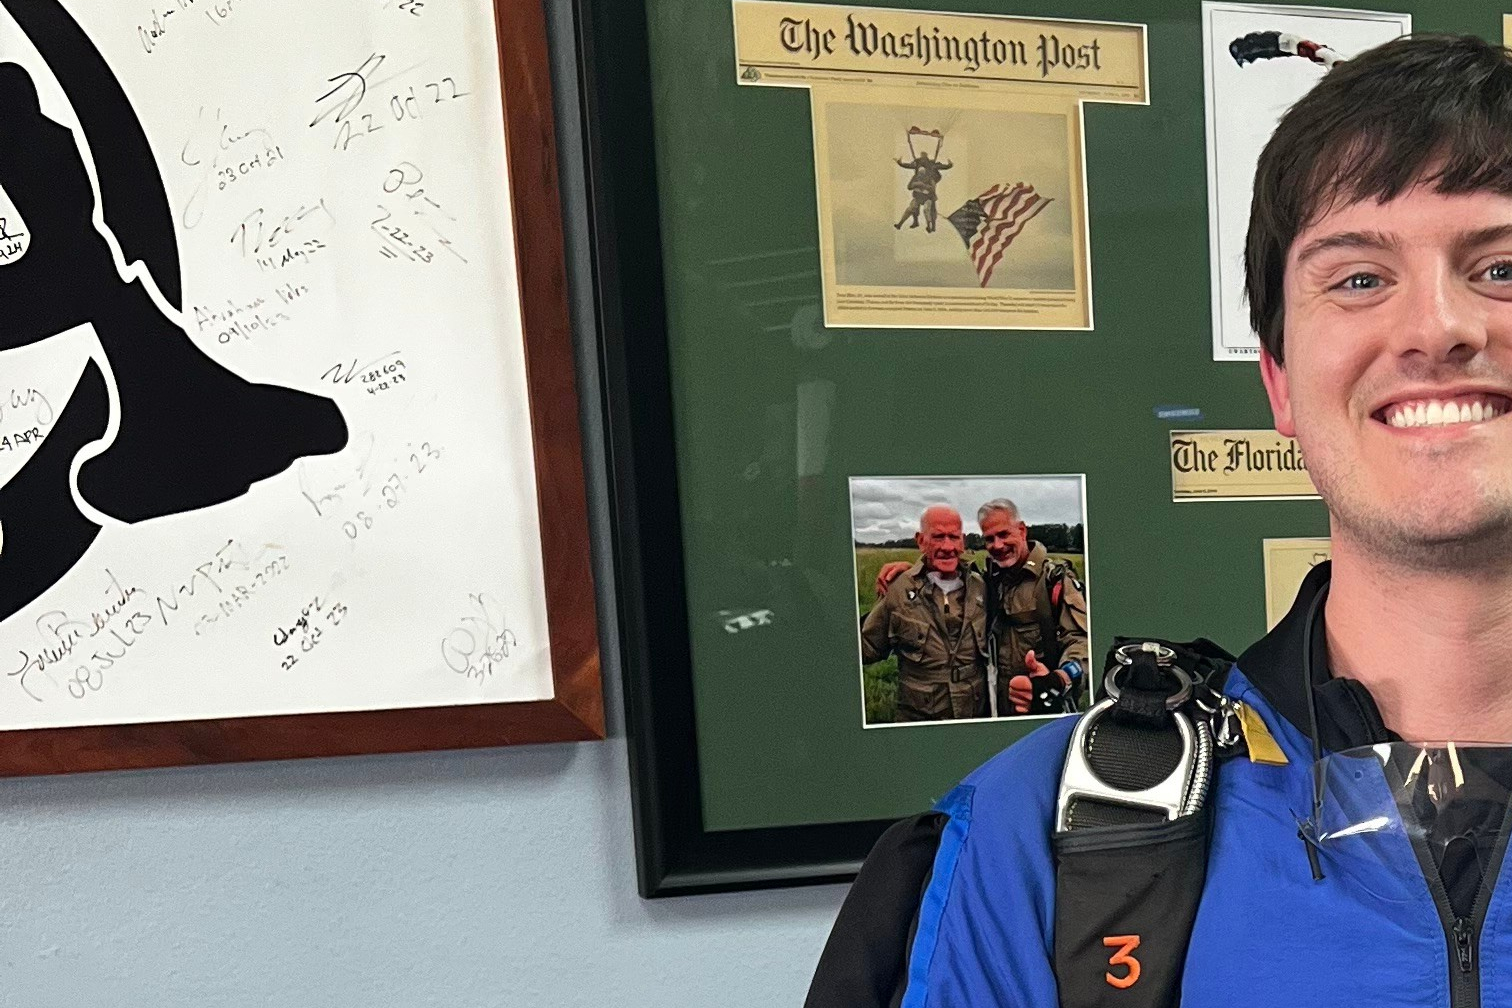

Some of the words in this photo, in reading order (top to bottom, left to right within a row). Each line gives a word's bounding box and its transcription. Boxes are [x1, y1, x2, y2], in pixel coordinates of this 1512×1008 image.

[779, 17, 836, 60] The
[844, 13, 1028, 73] Washington
[1035, 34, 1103, 78] Post
[1172, 437, 1219, 473] The
[1102, 934, 1142, 990] 3
